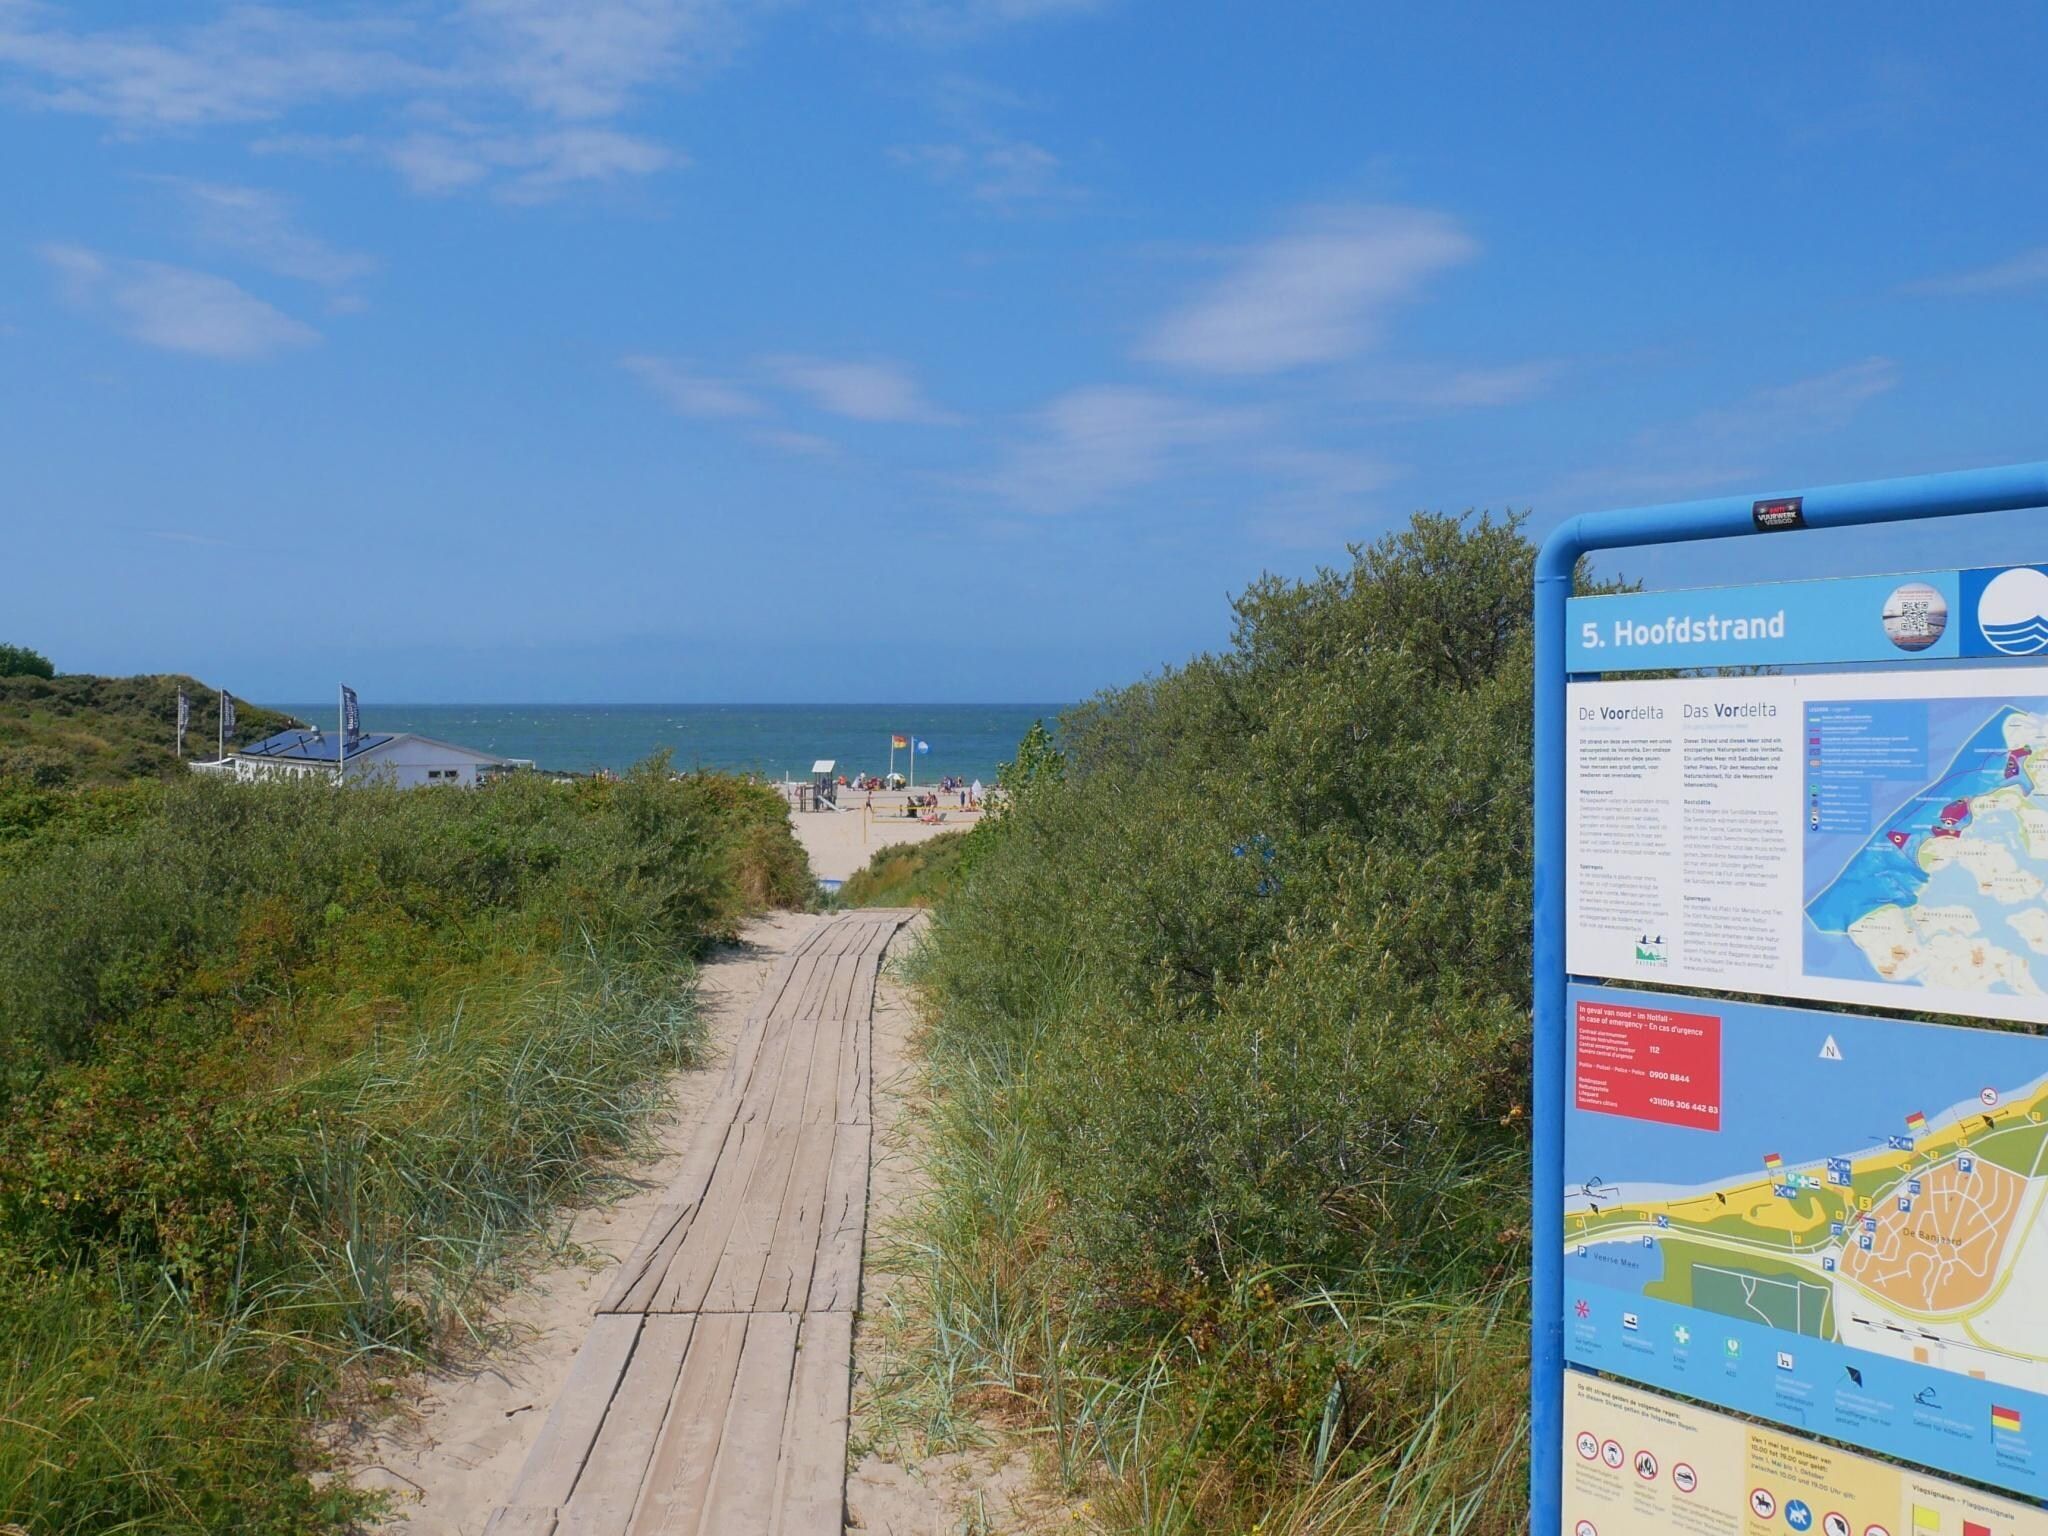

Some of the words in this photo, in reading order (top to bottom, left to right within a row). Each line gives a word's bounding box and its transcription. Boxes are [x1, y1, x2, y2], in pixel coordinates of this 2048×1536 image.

[1758, 512, 1797, 520] VUURWERK
[1582, 622, 1605, 648] 5.
[1614, 610, 1784, 647] Hoofdstrand
[1579, 707, 1596, 720] De
[1600, 706, 1664, 720] Voordelta
[1683, 704, 1708, 718] Das
[1714, 702, 1776, 717] Vordelta
[1586, 1008, 1602, 1016] geval
[1646, 1014, 1668, 1022] Notfall
[1609, 1020, 1642, 1030] emergency
[1649, 1022, 1658, 1031] En
[1671, 1026, 1704, 1036] d'urgence
[1649, 1046, 1660, 1054] 112
[1826, 1046, 1834, 1056] N
[1649, 1070, 1668, 1080] 0900
[1670, 1073, 1690, 1083] 8844
[1649, 1097, 1674, 1108] +31(0)6
[1676, 1100, 1690, 1110] 306
[1692, 1103, 1706, 1112] 442
[1708, 1106, 1718, 1114] 83
[1902, 1228, 1916, 1238] De
[1752, 1436, 1762, 1444] Van
[1768, 1440, 1779, 1448] mei
[1780, 1444, 1789, 1452] tot
[1796, 1450, 1818, 1460] oktober
